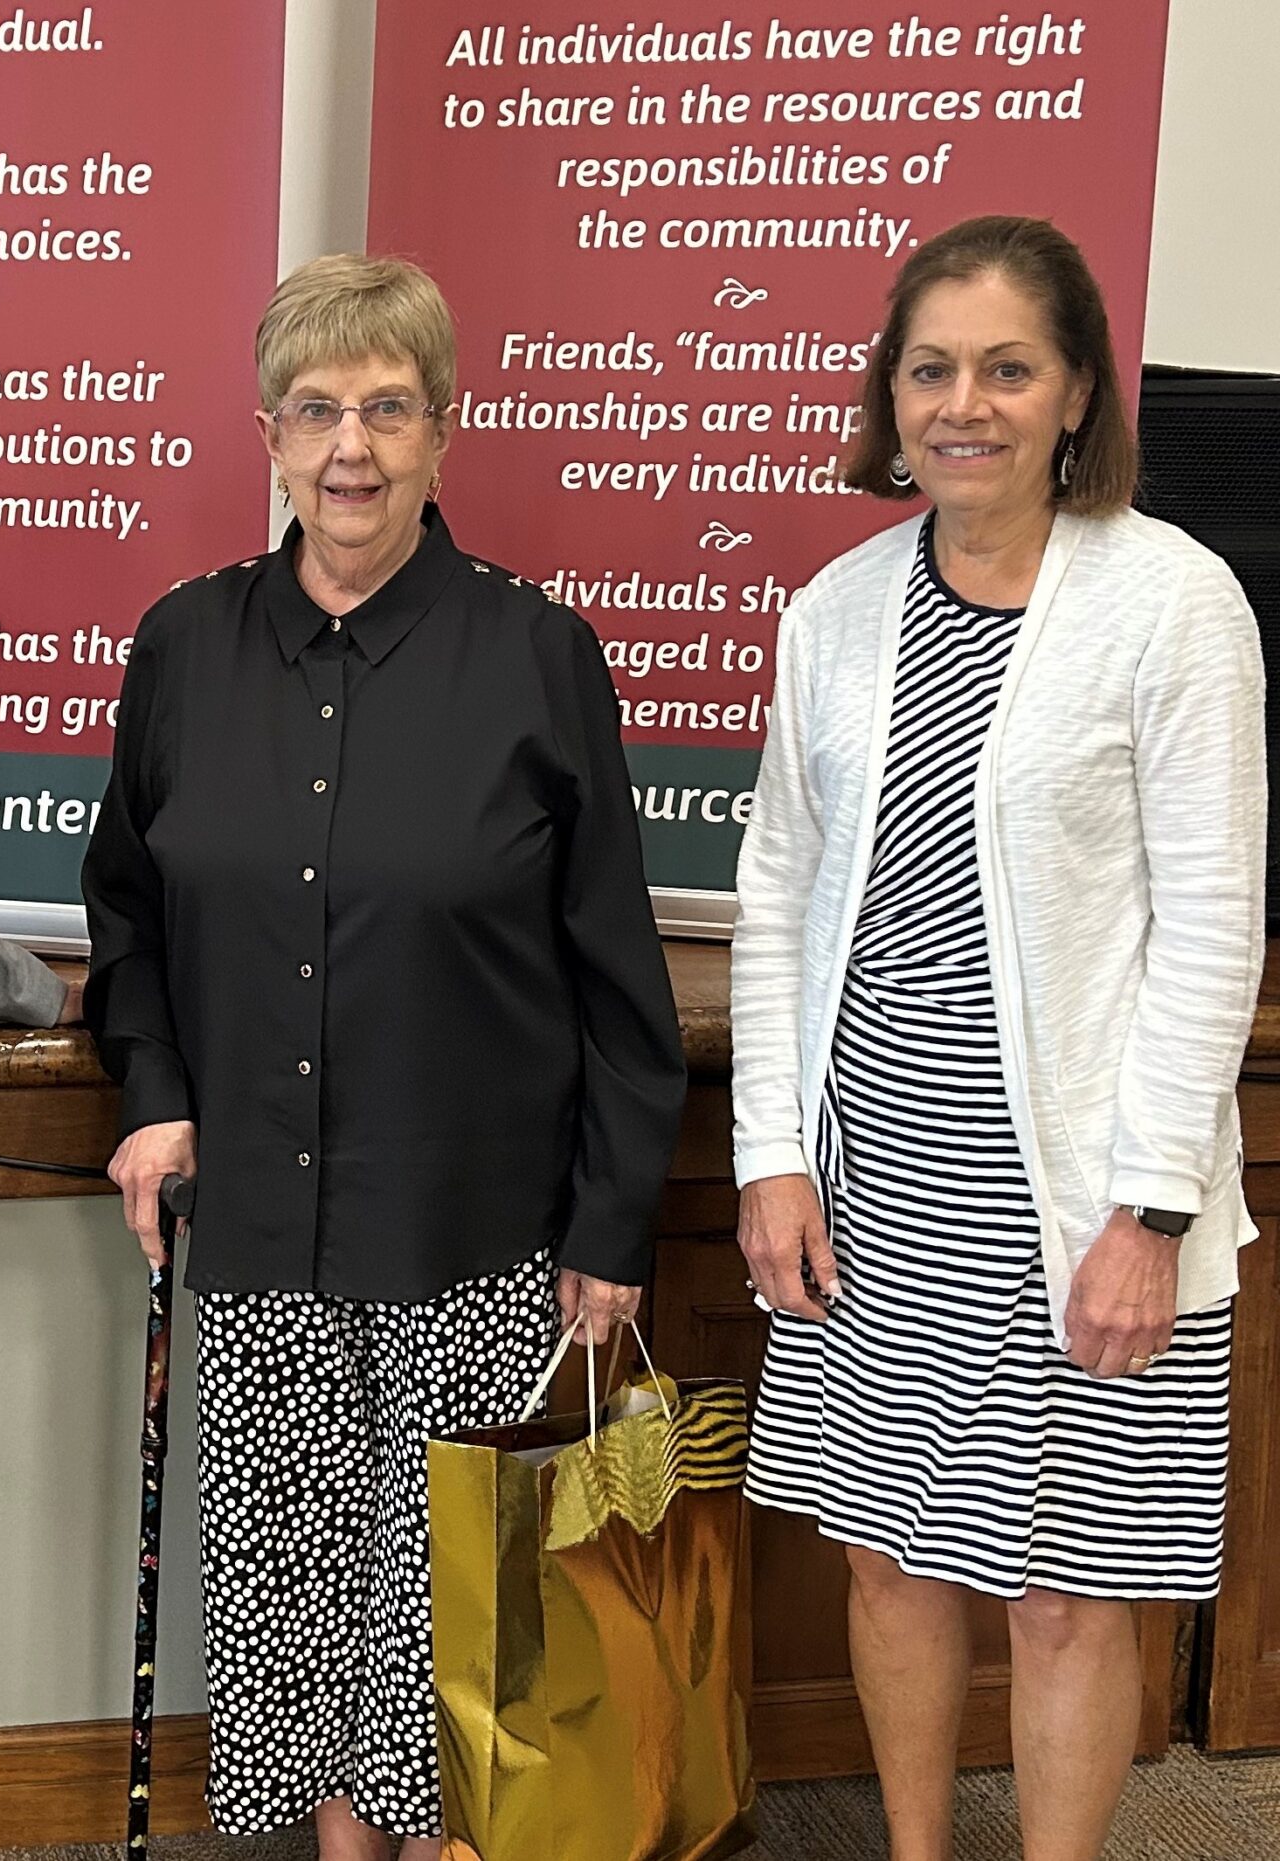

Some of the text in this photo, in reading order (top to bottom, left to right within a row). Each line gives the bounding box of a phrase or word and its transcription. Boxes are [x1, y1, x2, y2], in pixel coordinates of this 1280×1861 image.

[446, 13, 1086, 67] All individuals have the right
[444, 78, 1085, 129] to share in the resources and
[82, 152, 153, 195] the
[557, 143, 953, 197] responsibilities of
[578, 207, 918, 258] the community.
[501, 331, 664, 376] Friends,
[62, 360, 165, 402] their
[701, 403, 773, 433] are
[150, 431, 192, 468] to
[561, 462, 679, 501] every
[599, 632, 764, 678] aged to
[631, 784, 757, 825] urce
